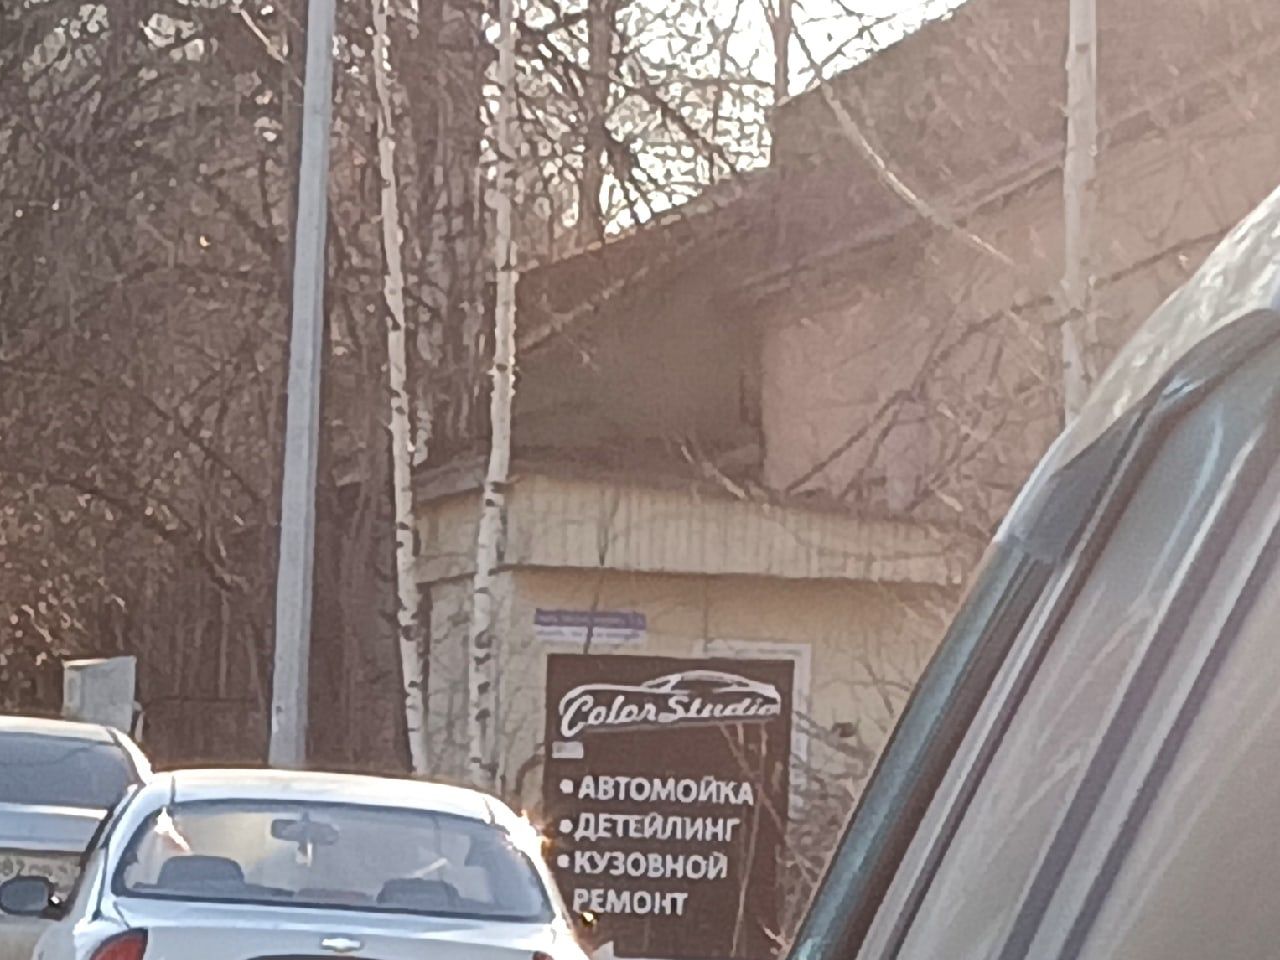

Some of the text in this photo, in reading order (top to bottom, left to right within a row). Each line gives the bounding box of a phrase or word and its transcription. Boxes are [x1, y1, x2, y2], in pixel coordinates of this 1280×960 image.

[561, 695, 781, 737] Color Studio
[578, 775, 754, 806] АВТОМОЙКА
[574, 812, 740, 842] ДЕТЕЙЛИНГ
[574, 850, 728, 879] КУЗОВНОЙ
[573, 887, 688, 916] РЕМОНТ
